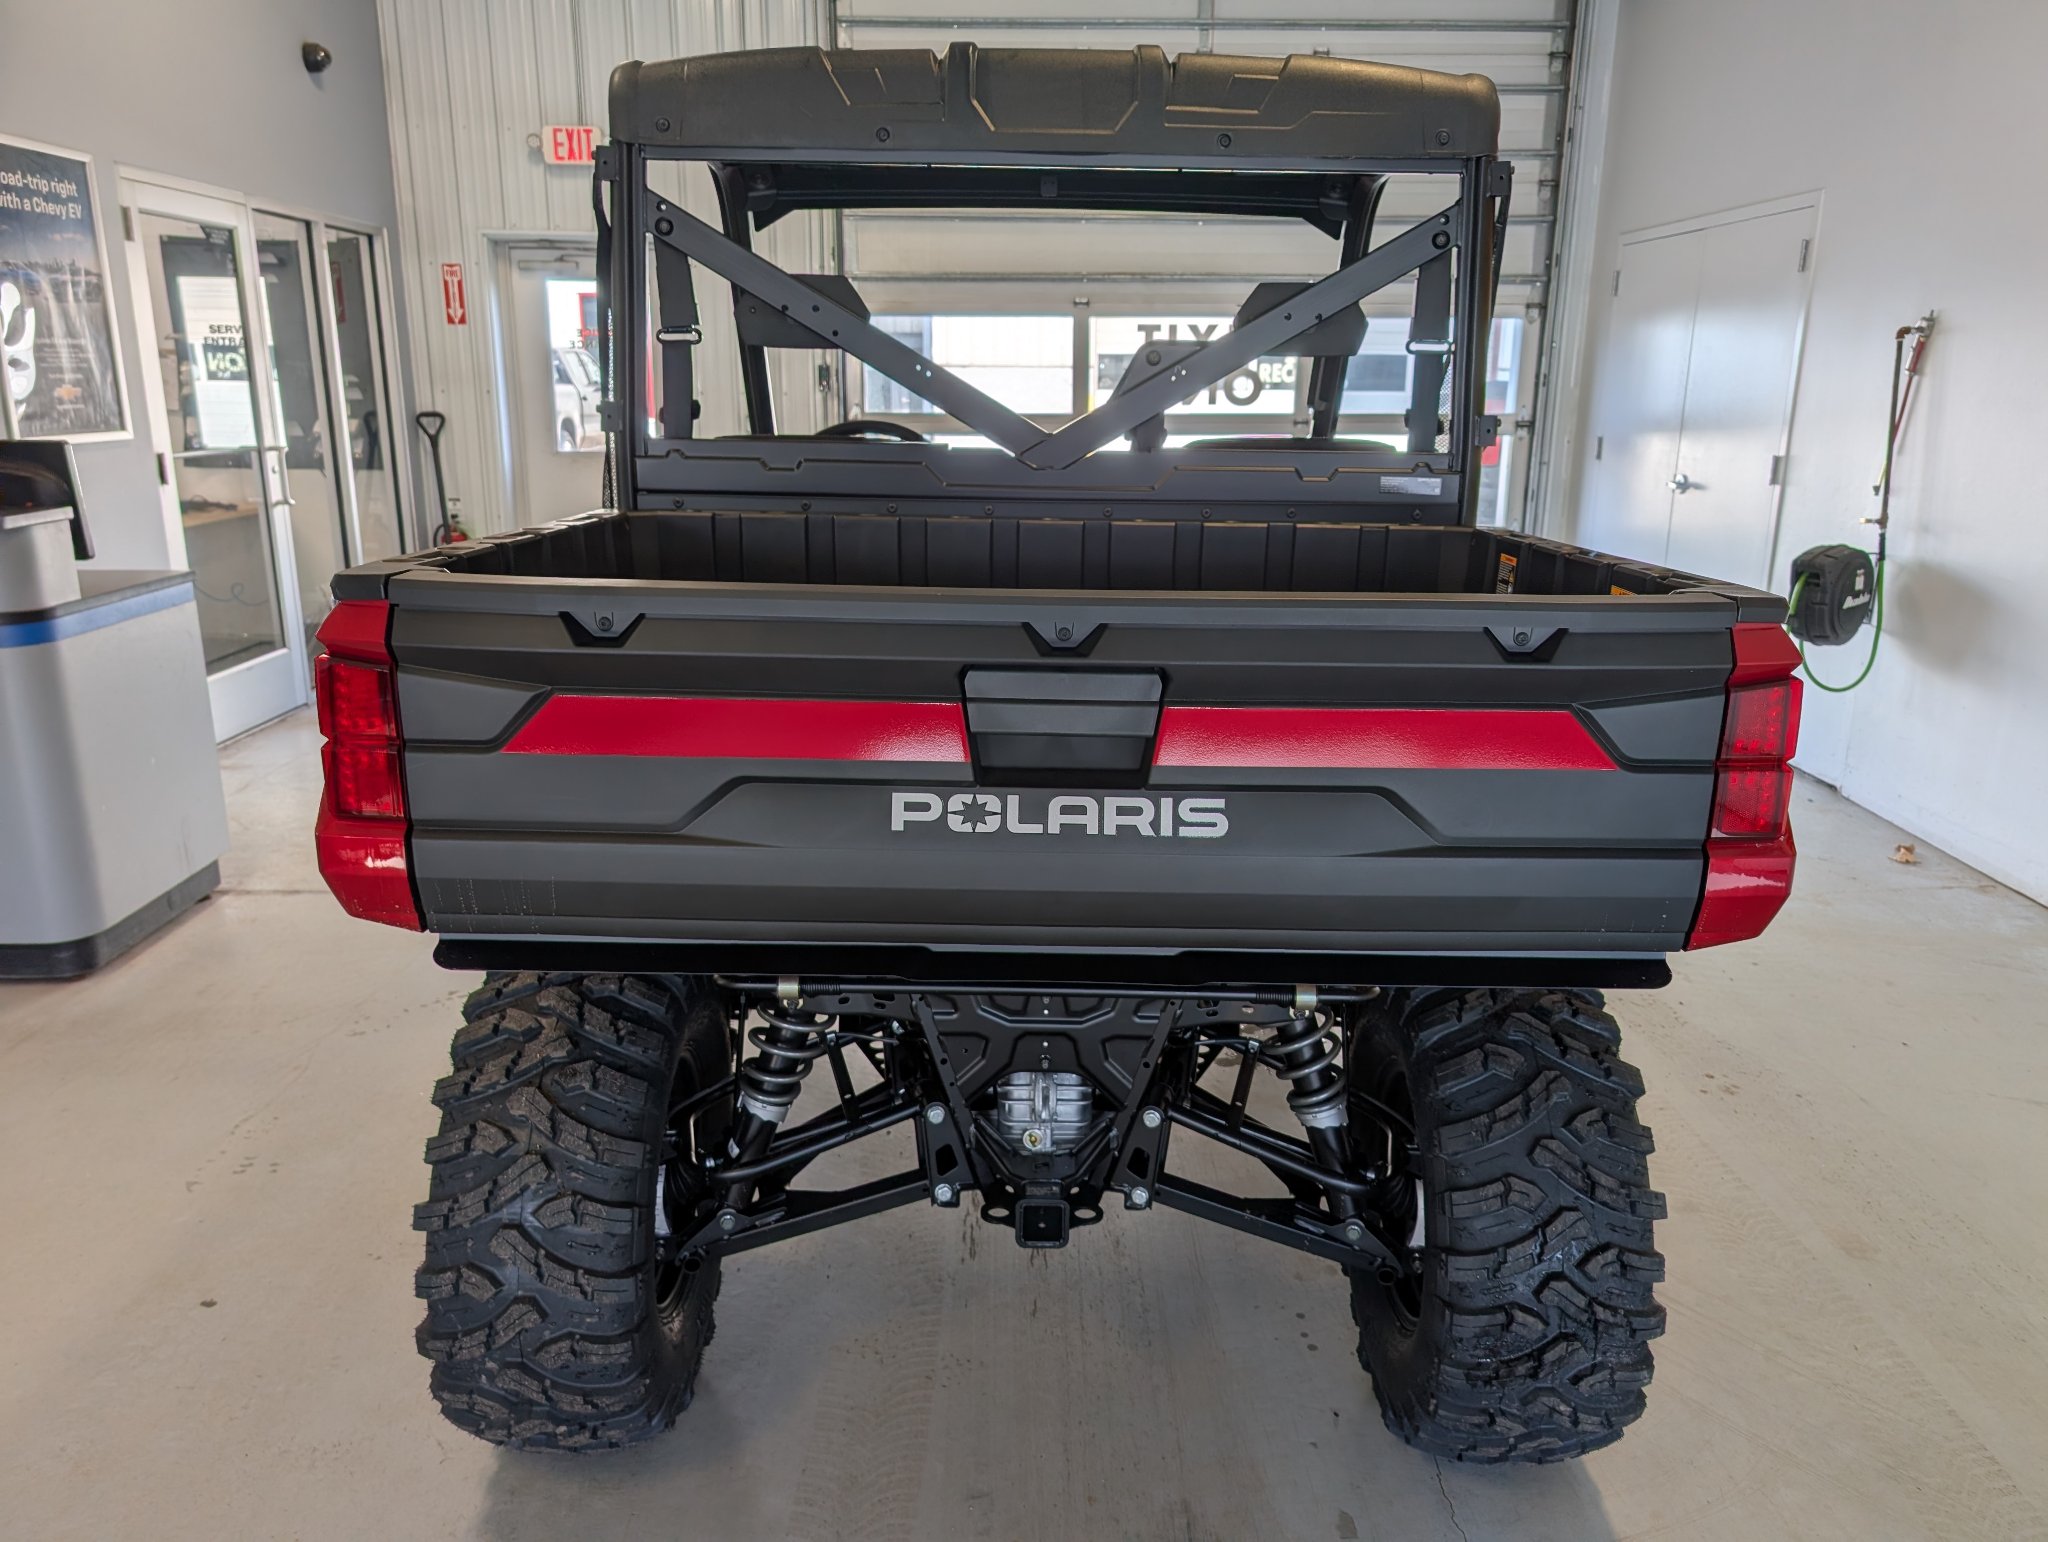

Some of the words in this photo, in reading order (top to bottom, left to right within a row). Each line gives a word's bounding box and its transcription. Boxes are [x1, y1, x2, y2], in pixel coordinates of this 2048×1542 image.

[553, 128, 593, 160] EXIT
[0, 170, 49, 195] oad-trip
[51, 177, 78, 198] right
[23, 198, 31, 211] a
[33, 196, 67, 220] Chevy
[69, 202, 82, 219] EV
[208, 324, 242, 334] SERV
[204, 336, 245, 347] ENTRA
[1258, 362, 1297, 383] REC
[891, 792, 1230, 838] POLARIS
